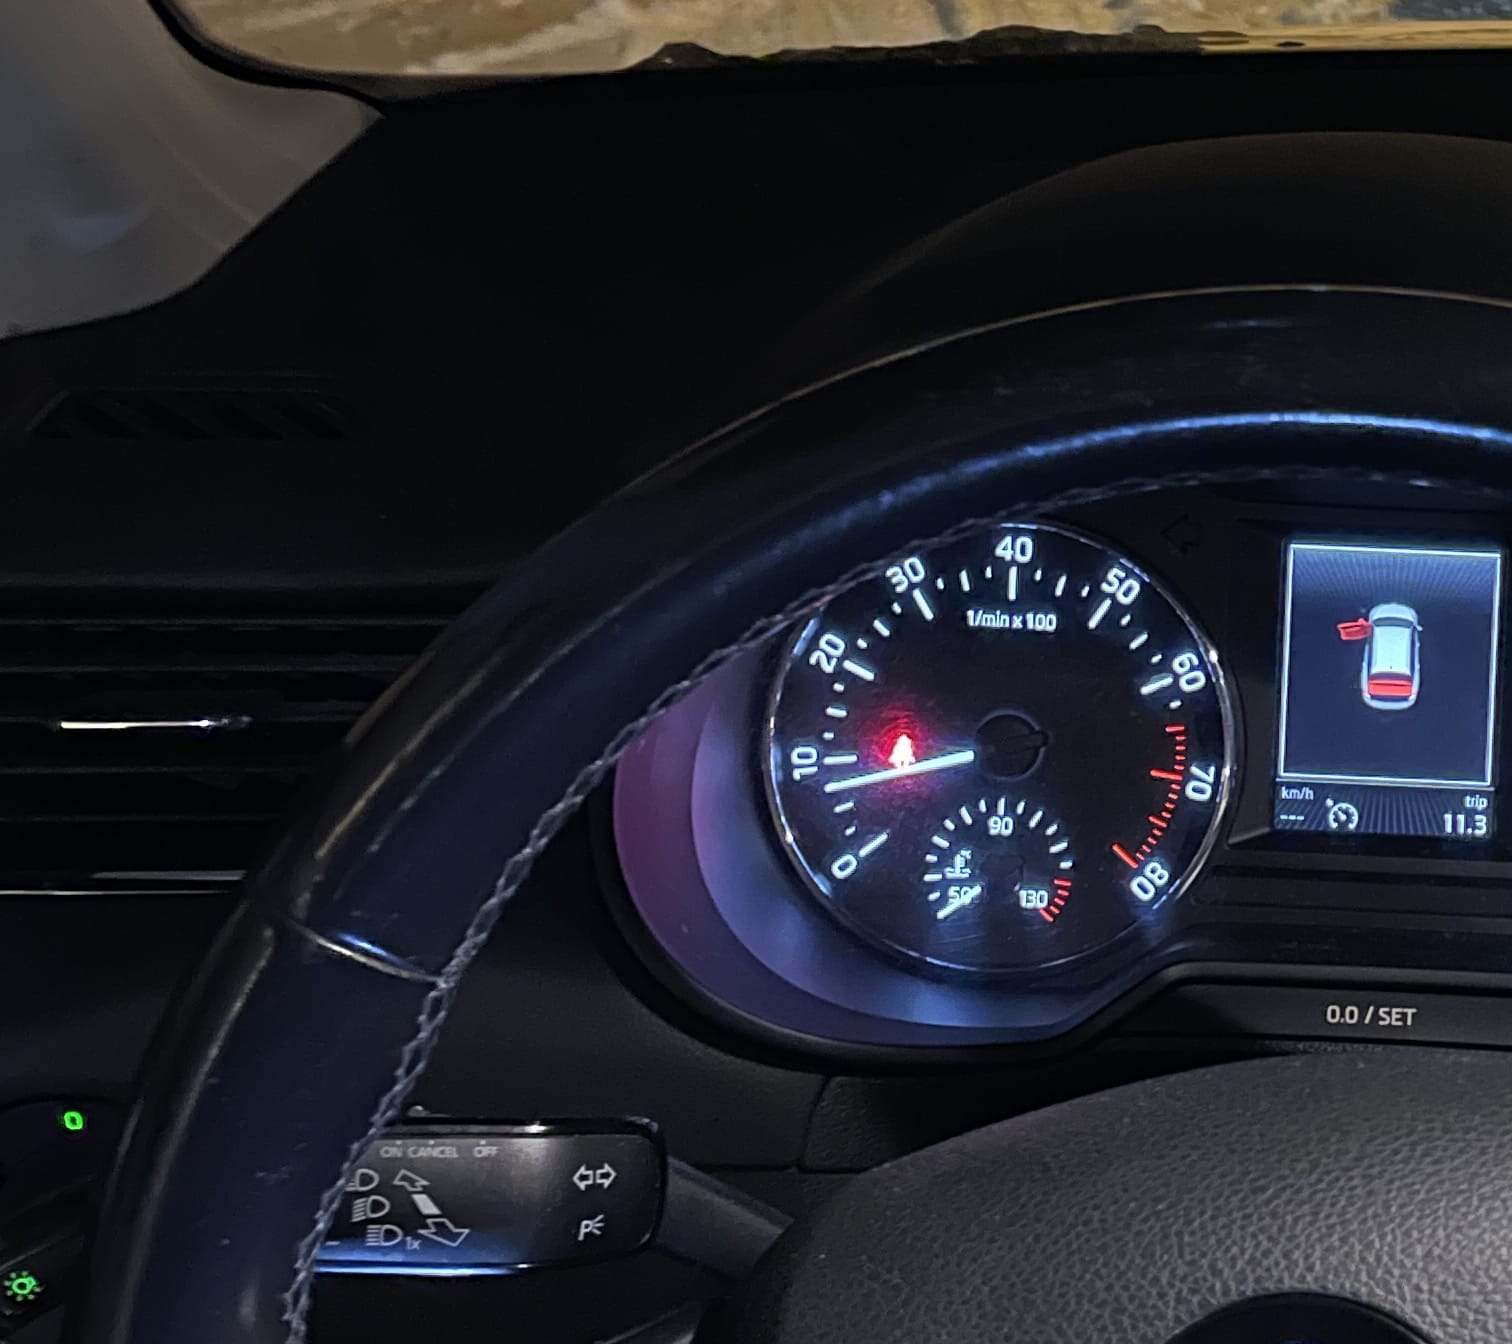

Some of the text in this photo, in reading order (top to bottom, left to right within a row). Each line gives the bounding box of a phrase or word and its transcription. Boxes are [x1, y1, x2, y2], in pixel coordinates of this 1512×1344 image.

[995, 536, 1033, 563] 40
[885, 556, 926, 594] 30
[1101, 567, 1140, 605] 50
[966, 610, 1010, 629] 1/min
[1025, 612, 1057, 631] 100
[809, 633, 846, 673] 20
[1172, 652, 1206, 693] 60
[790, 746, 819, 780] 10
[1184, 765, 1217, 802] 70
[1281, 787, 1314, 801] km/h
[1464, 795, 1488, 810] trip
[987, 817, 1014, 837] 90
[1443, 813, 1487, 834] 11.3
[830, 855, 858, 880] 0
[1129, 861, 1171, 902] 80
[1018, 889, 1049, 909] 130
[1325, 1004, 1359, 1025] 0.0
[1378, 1007, 1417, 1027] SET
